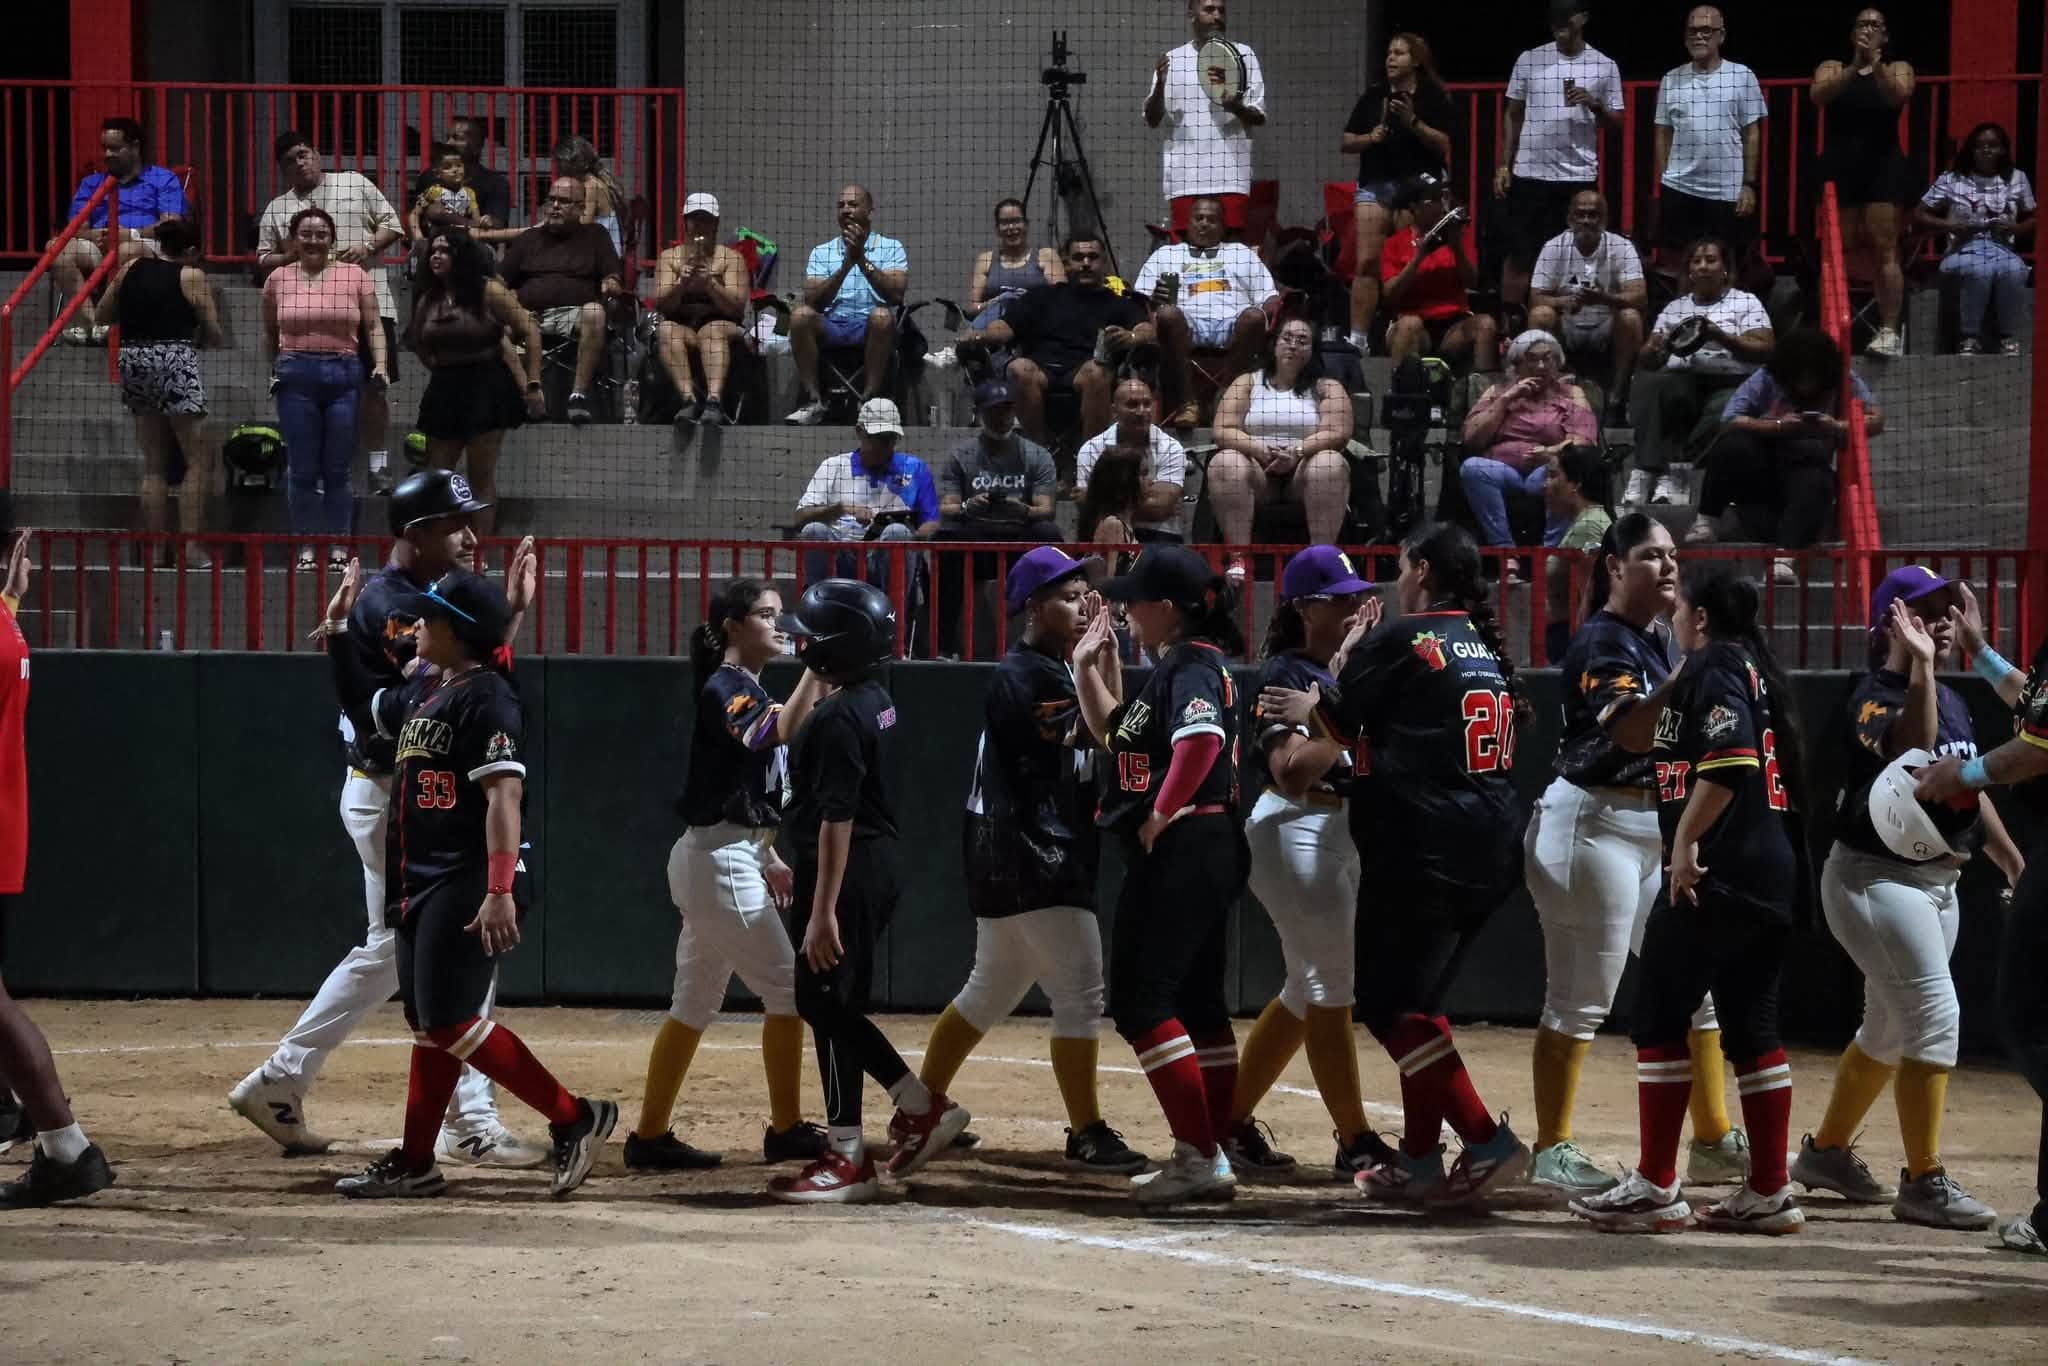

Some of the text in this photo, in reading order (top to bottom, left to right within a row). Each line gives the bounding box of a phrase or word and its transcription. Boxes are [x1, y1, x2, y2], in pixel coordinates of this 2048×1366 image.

[972, 475, 1025, 489] COACH
[1461, 690, 1515, 773] 20
[416, 769, 457, 809] 33
[1118, 752, 1151, 791] 15
